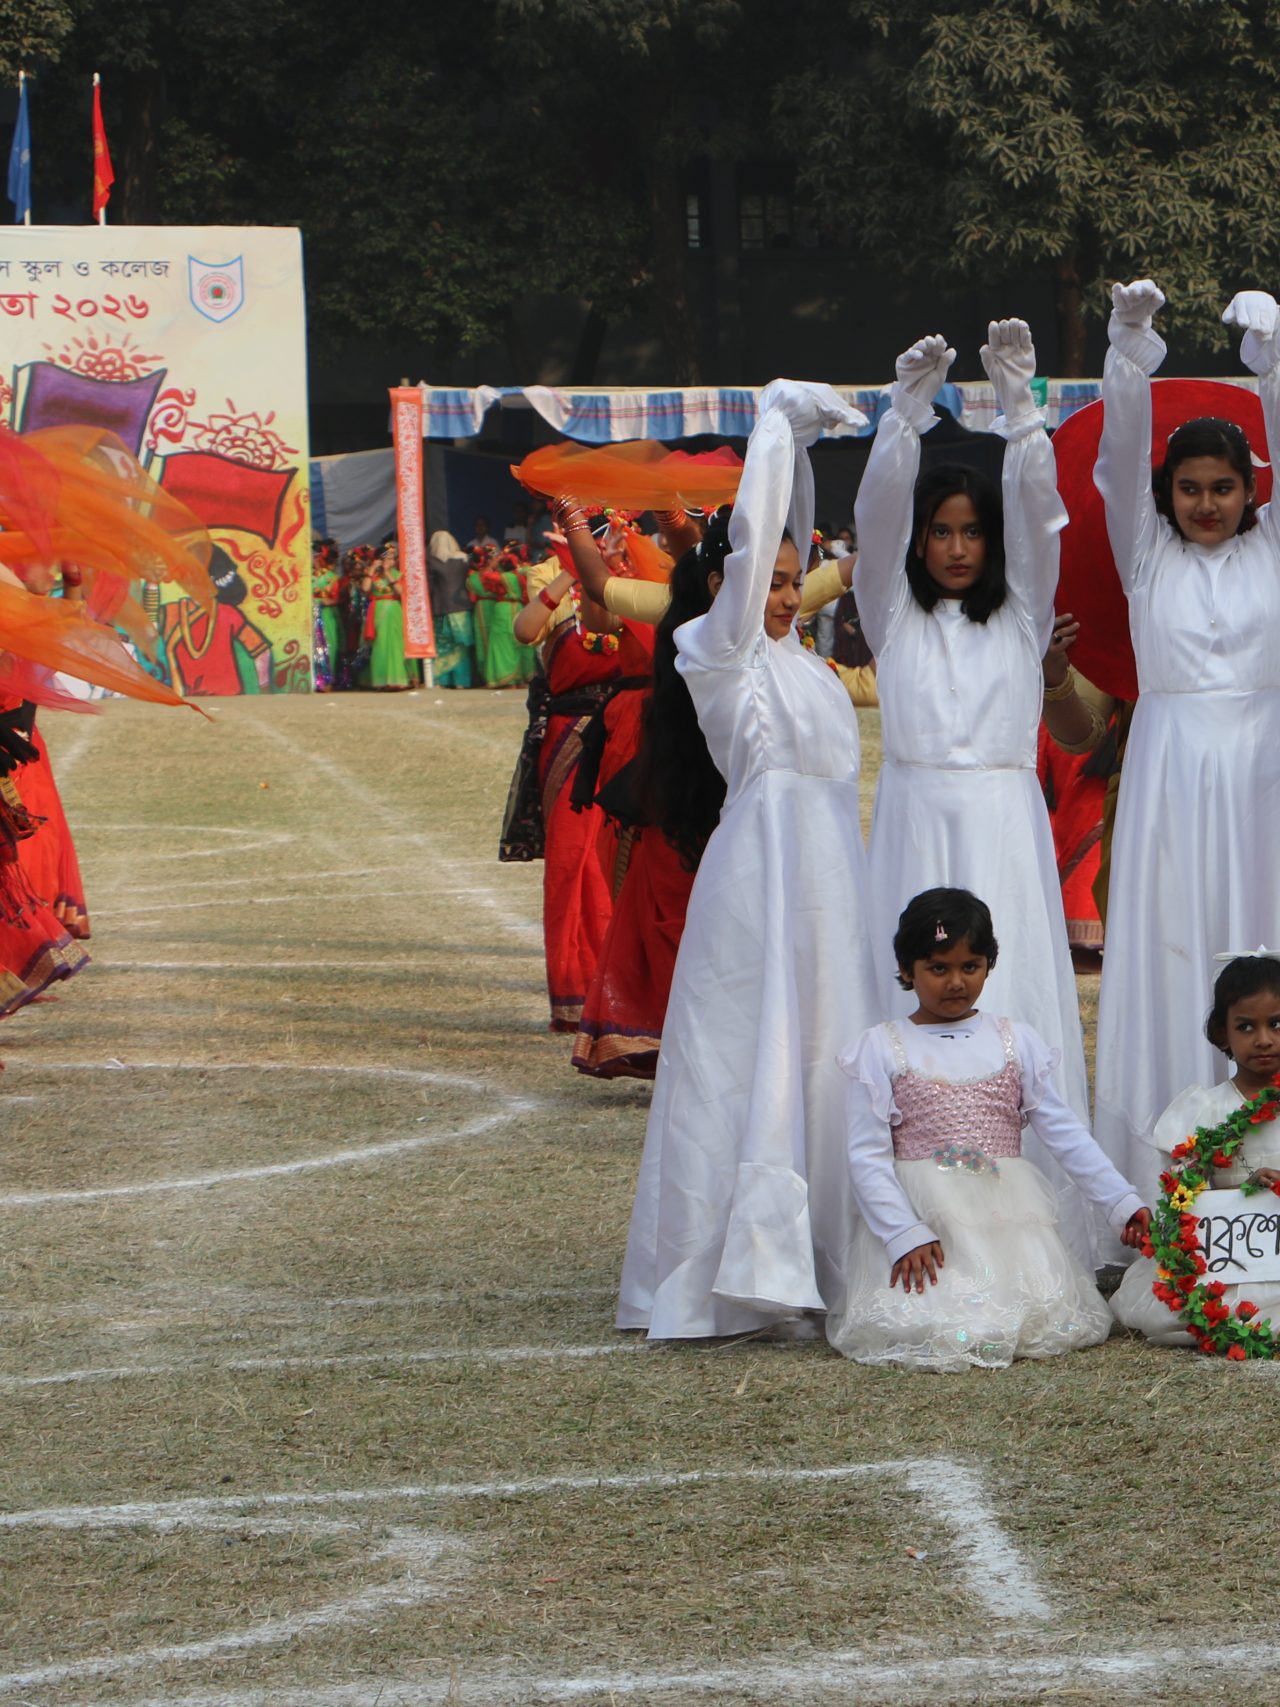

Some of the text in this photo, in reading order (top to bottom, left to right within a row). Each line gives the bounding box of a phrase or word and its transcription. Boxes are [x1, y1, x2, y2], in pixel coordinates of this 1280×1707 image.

[19, 260, 63, 284] স্কুল
[72, 260, 90, 277] ও
[99, 260, 170, 278] কলেজ
[52, 294, 149, 322] ২০২৬
